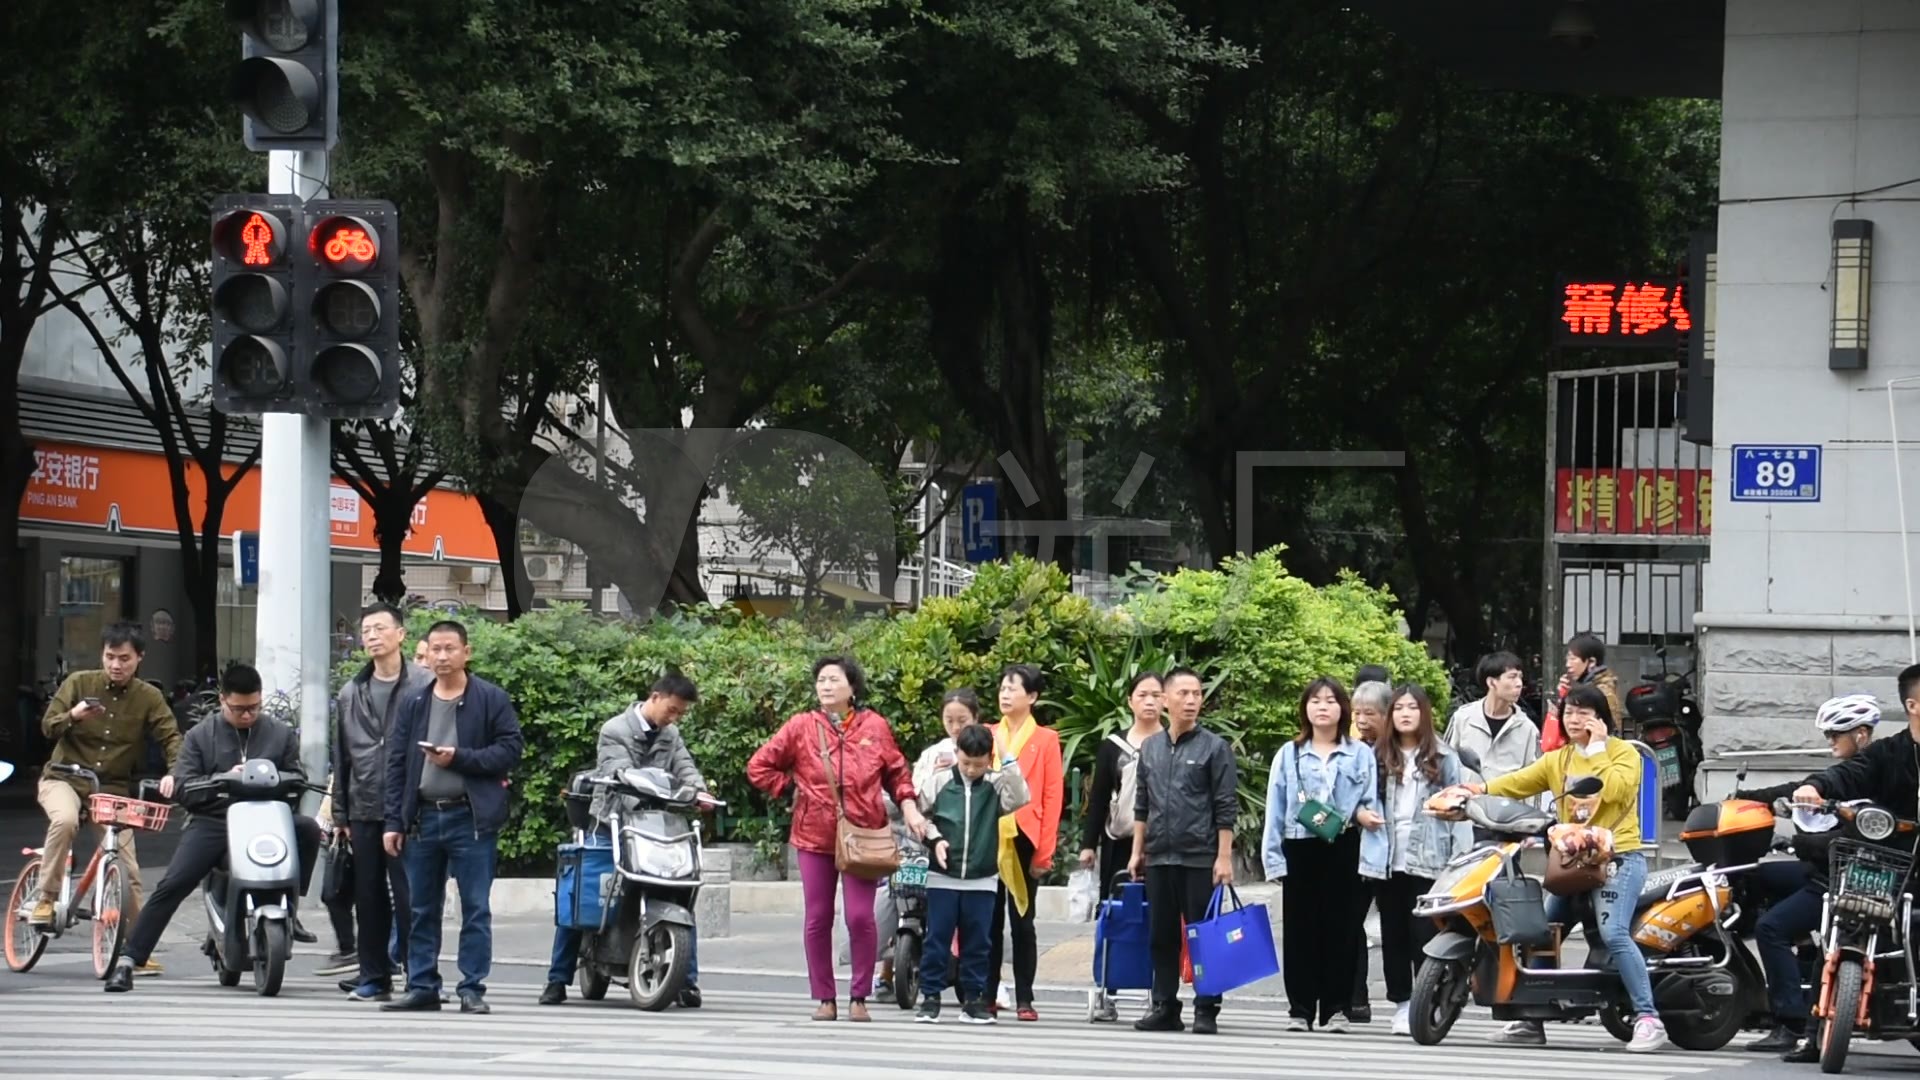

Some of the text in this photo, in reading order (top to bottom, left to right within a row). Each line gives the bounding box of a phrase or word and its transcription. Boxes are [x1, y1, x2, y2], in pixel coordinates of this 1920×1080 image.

[31, 451, 99, 490] 平安银行
[1756, 461, 1795, 487] 89
[27, 492, 77, 508] PING AN BANK
[966, 497, 984, 551] P
[1600, 890, 1618, 900] DID
